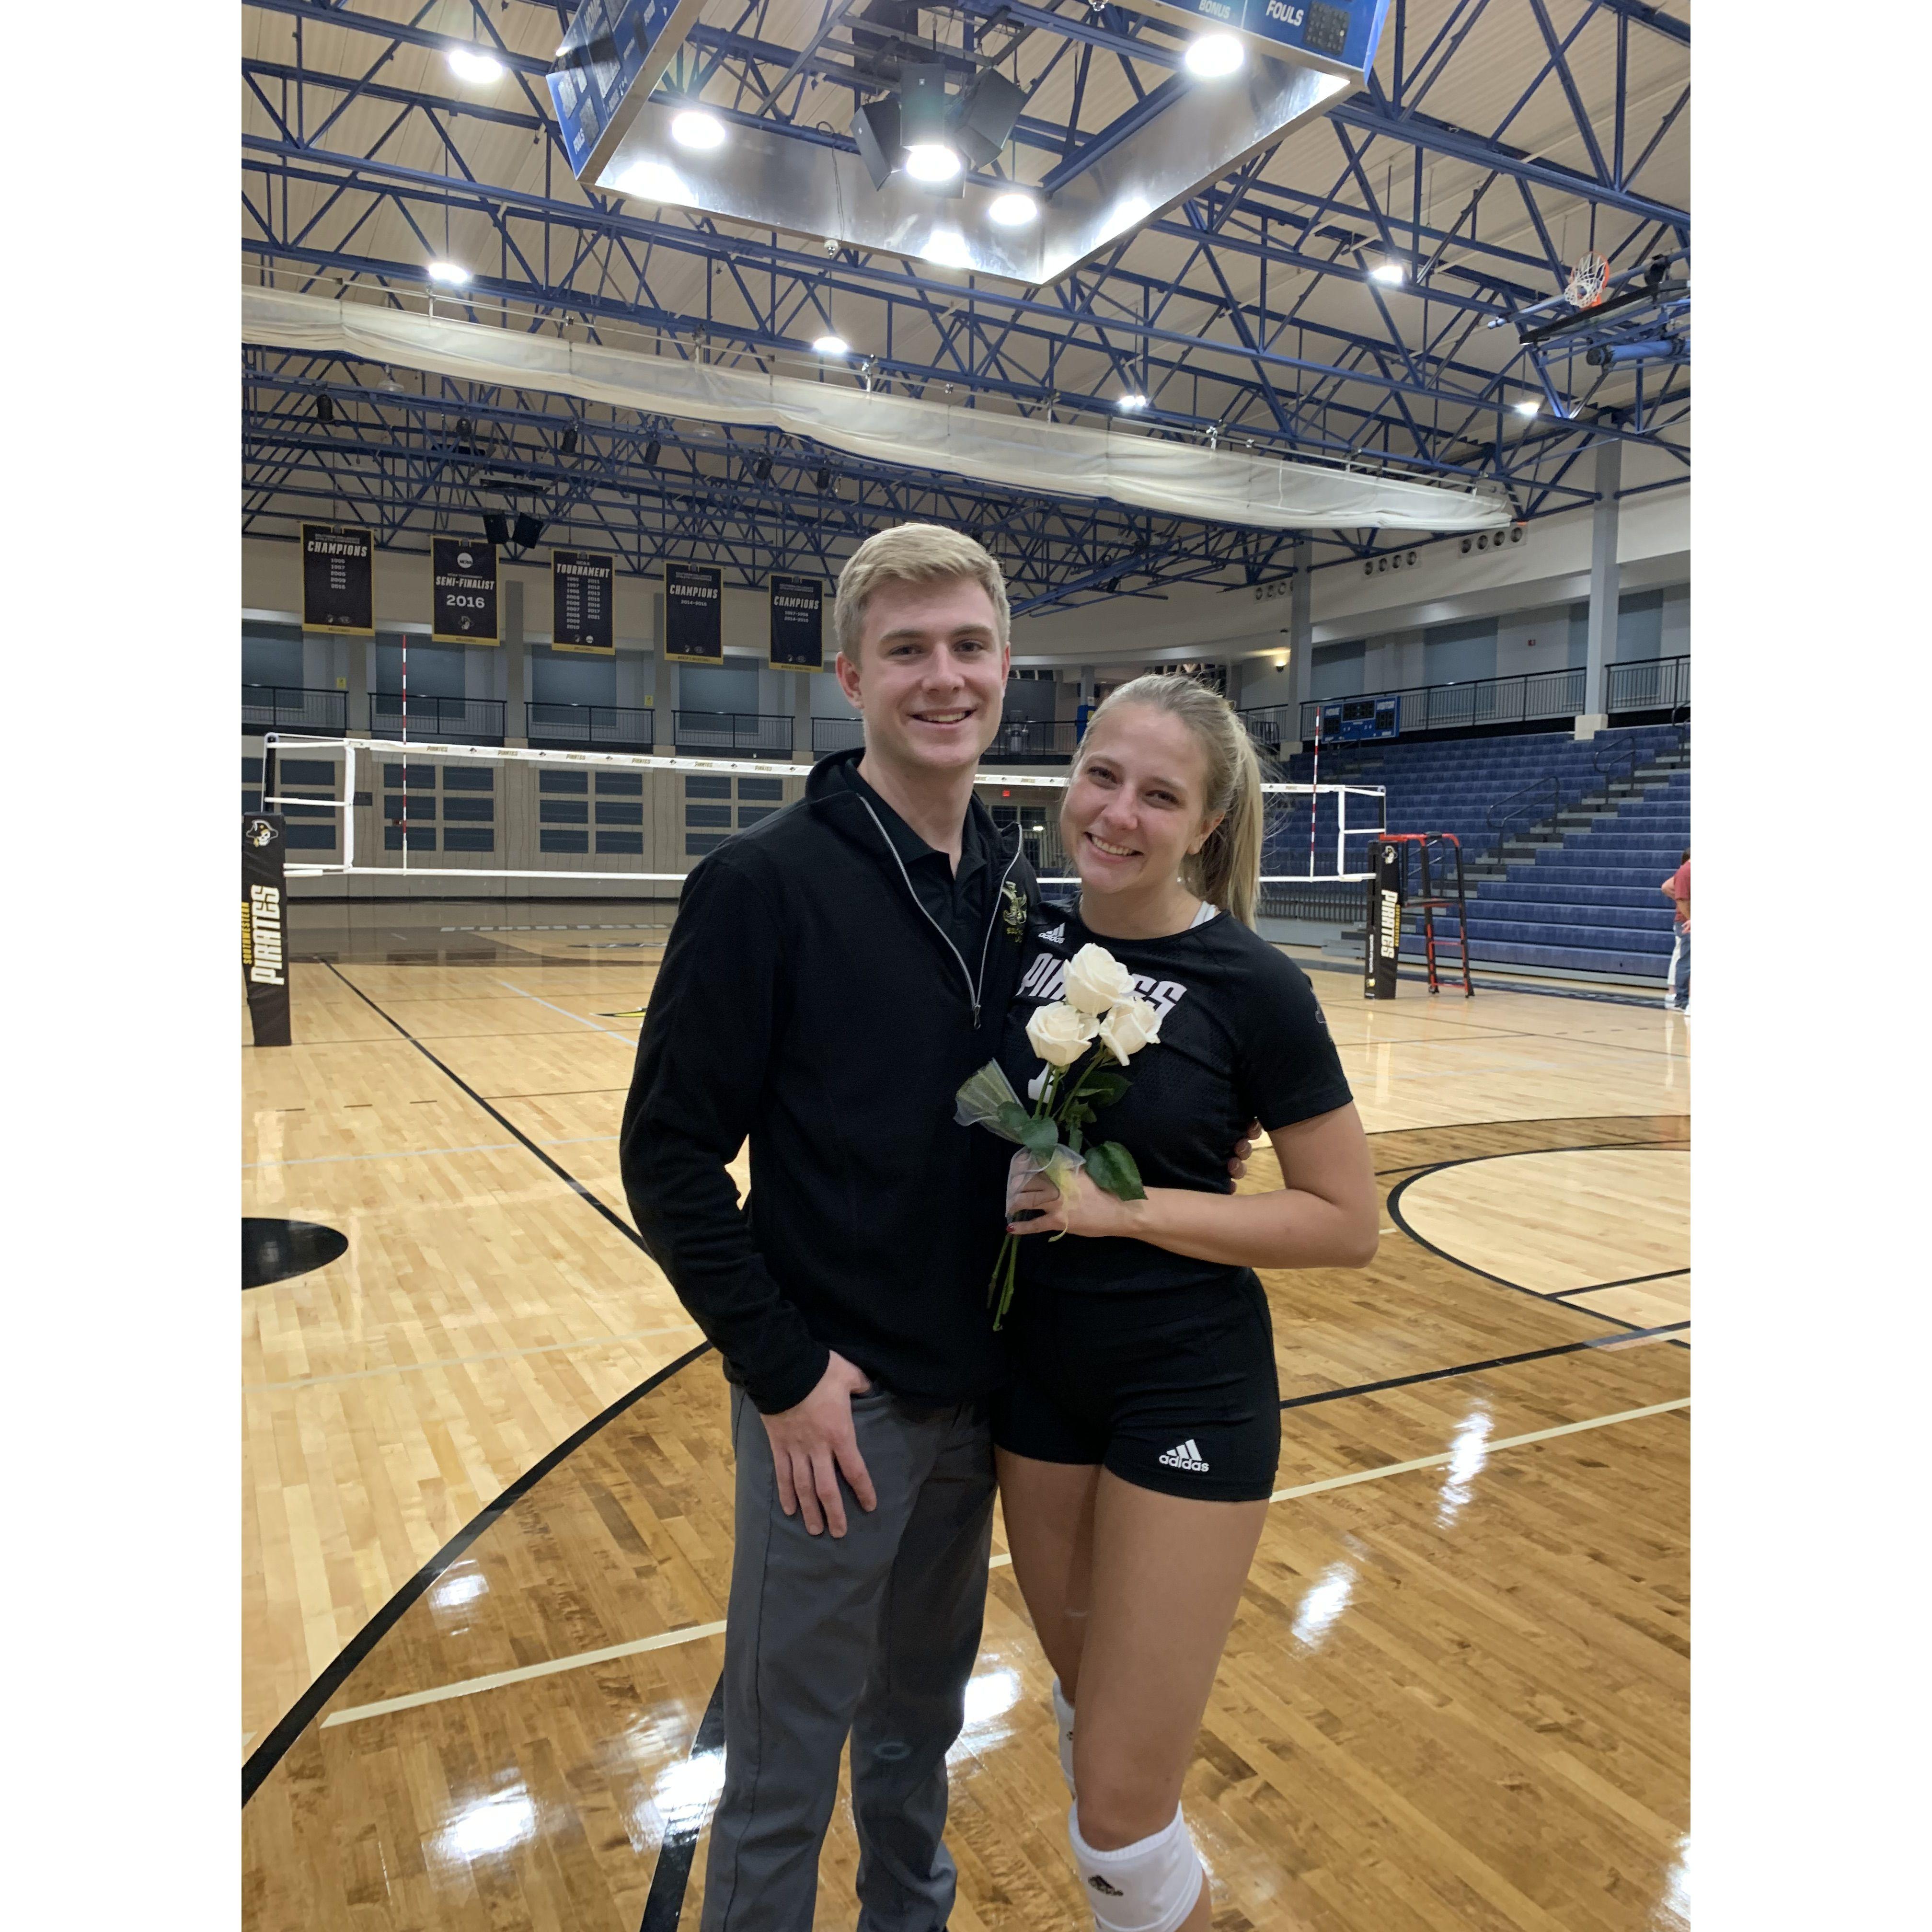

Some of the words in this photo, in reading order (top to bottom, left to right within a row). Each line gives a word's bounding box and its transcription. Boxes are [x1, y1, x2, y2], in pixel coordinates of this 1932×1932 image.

[1198, 0, 1231, 19] BONUS
[1265, 0, 1304, 26] FOULS
[308, 540, 368, 557] CHAMPIONS
[557, 564, 610, 578] TOURNAMENT
[436, 576, 494, 590] SEMI-FINALIST
[670, 585, 718, 598] CHAMPIONS
[447, 595, 485, 609] 2016
[774, 596, 819, 610] CHAMPIONS
[1381, 889, 1398, 959] PIRATES
[242, 902, 252, 965] SOUTHWESTERN
[251, 884, 285, 985] PIRATES
[1038, 932, 1065, 944] adidas
[1159, 1455, 1209, 1472] adidas
